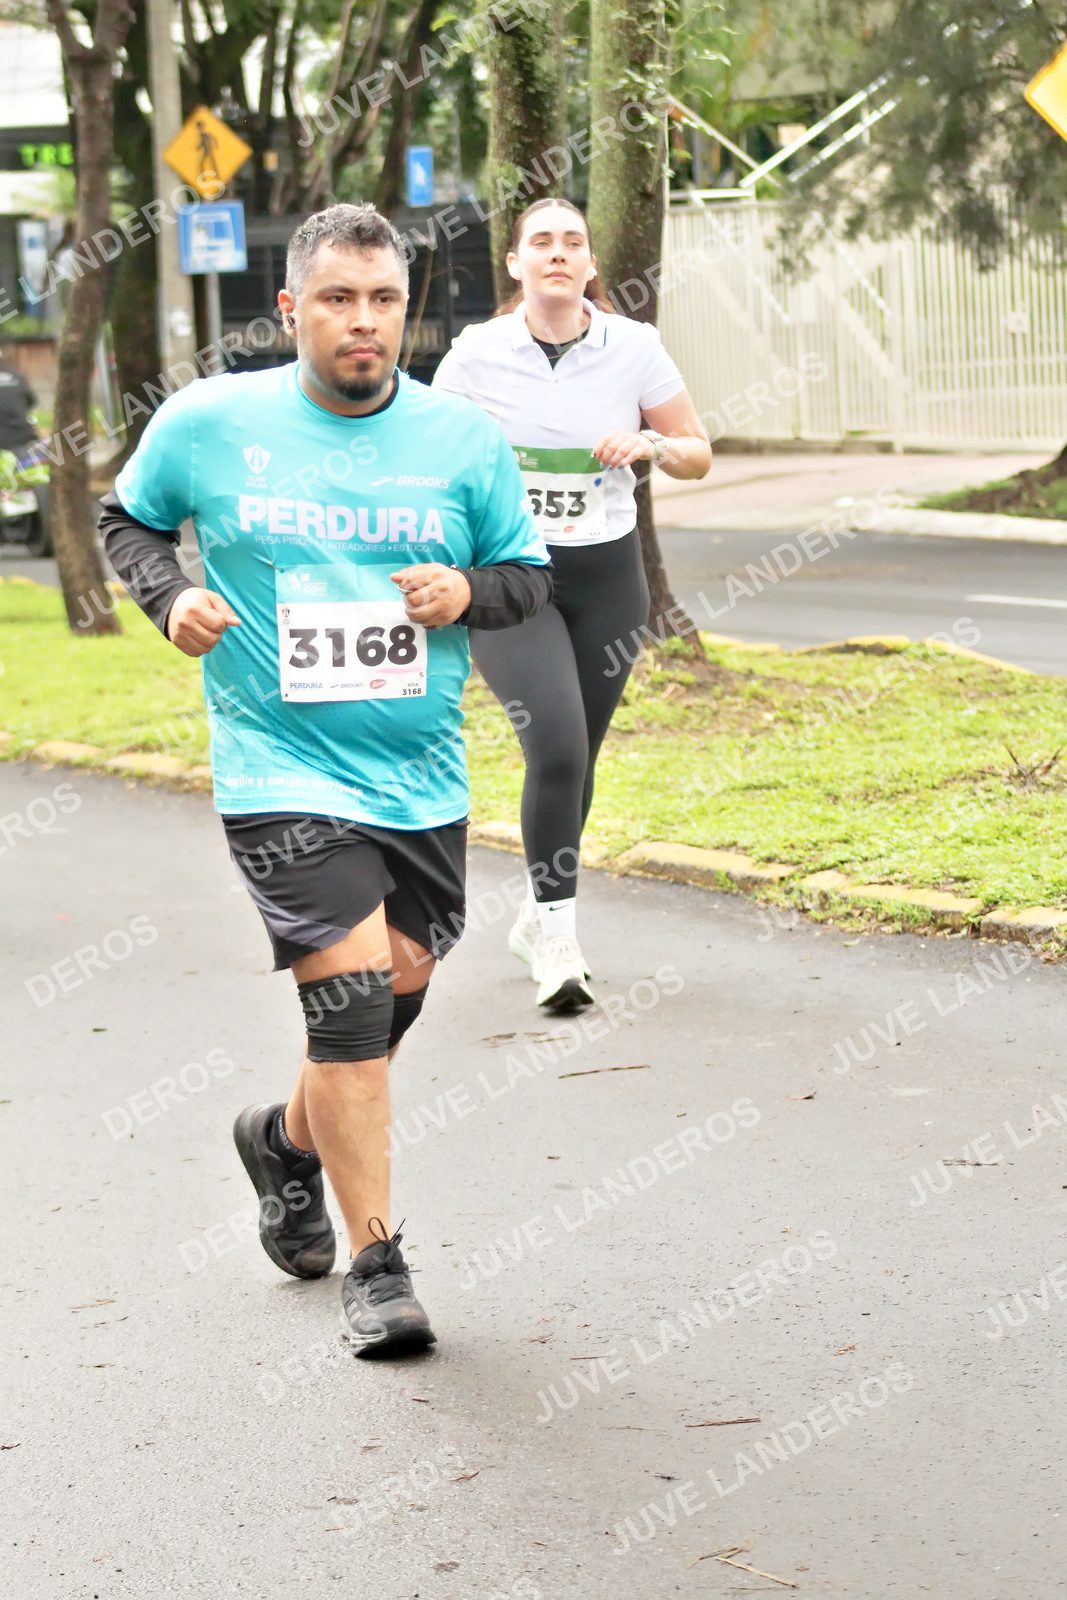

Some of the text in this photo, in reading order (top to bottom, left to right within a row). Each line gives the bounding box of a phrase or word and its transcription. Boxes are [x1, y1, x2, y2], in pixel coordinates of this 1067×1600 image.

[396, 475, 451, 489] BROOKS
[238, 494, 445, 544] PERDURA
[255, 535, 280, 545] PEGA
[322, 539, 386, 553] NTEADORES
[289, 625, 418, 668] 3168
[402, 687, 422, 696] 3168
